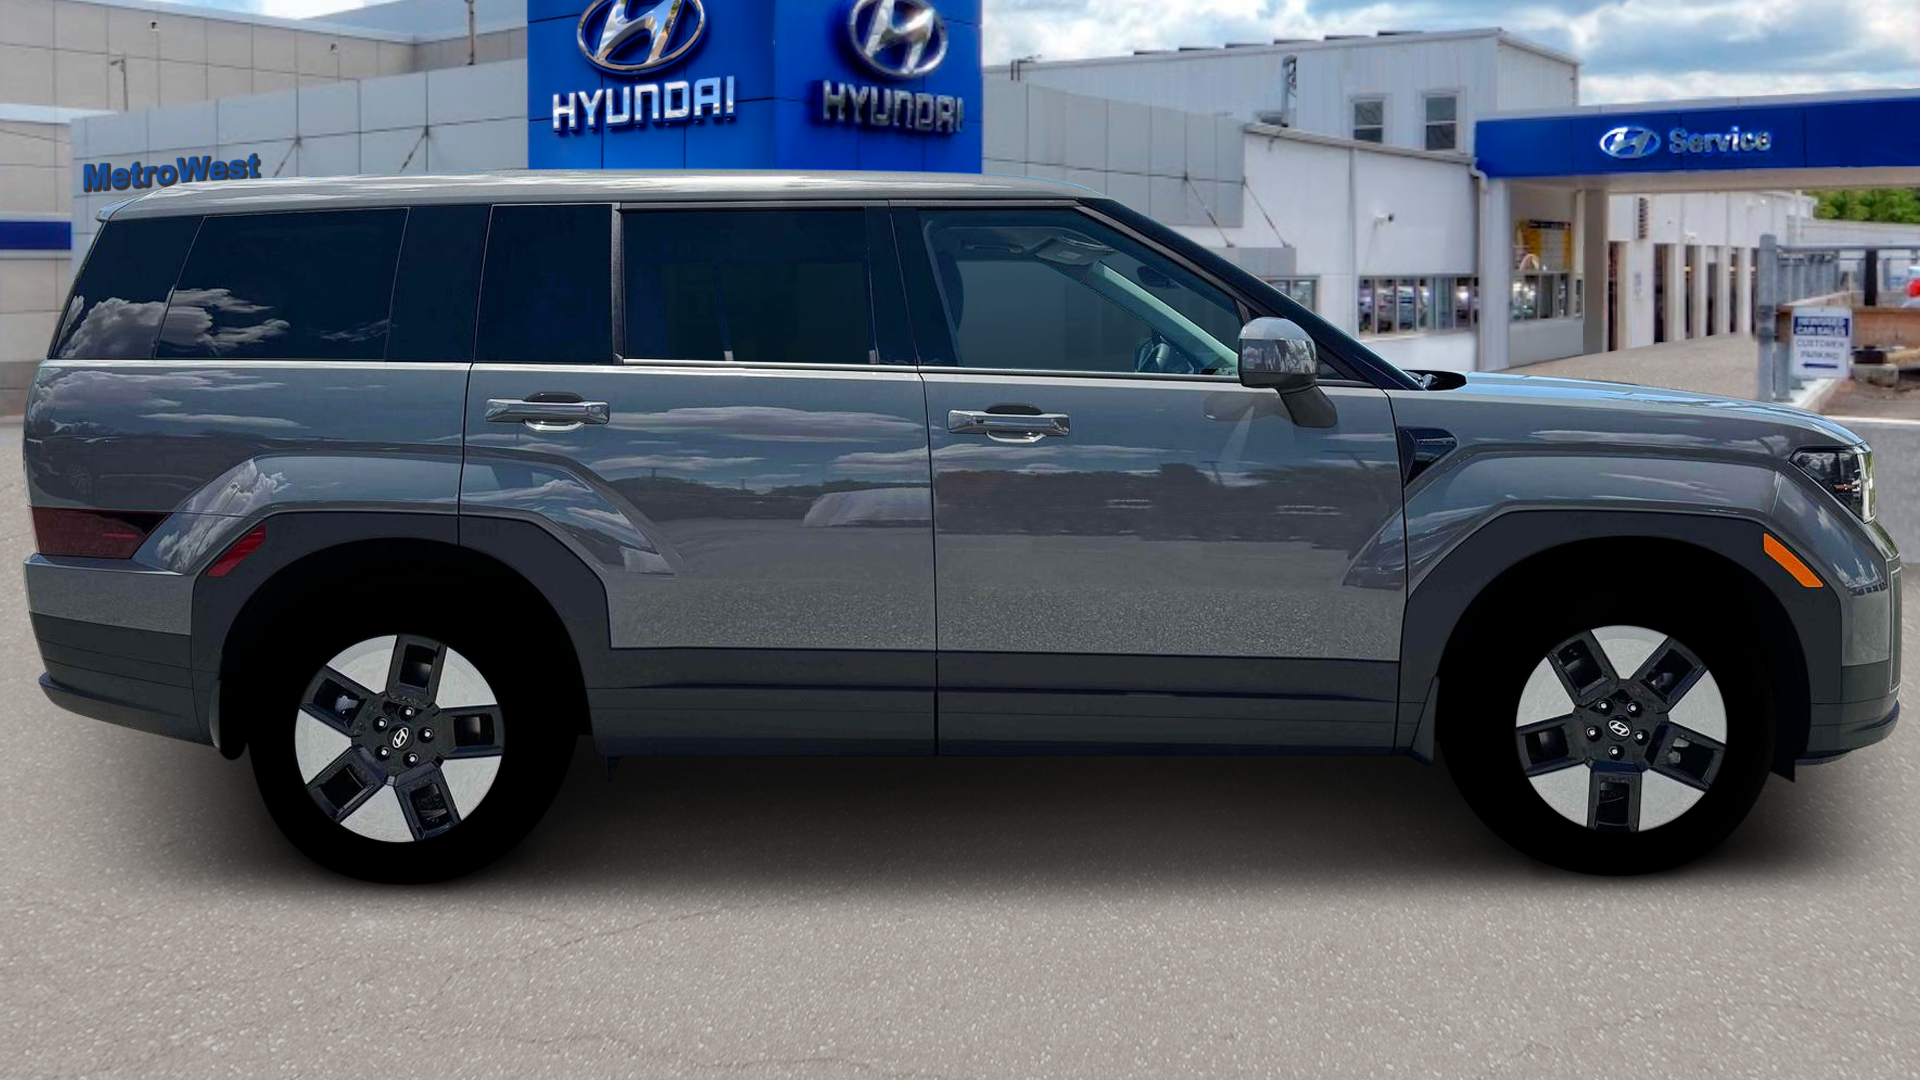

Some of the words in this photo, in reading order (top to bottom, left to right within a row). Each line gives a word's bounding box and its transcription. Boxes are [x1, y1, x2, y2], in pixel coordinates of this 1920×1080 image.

[552, 76, 736, 133] HYUNDAI
[822, 79, 964, 133] HYUNDAI
[1669, 126, 1772, 154] Service
[83, 153, 261, 192] MetroWest
